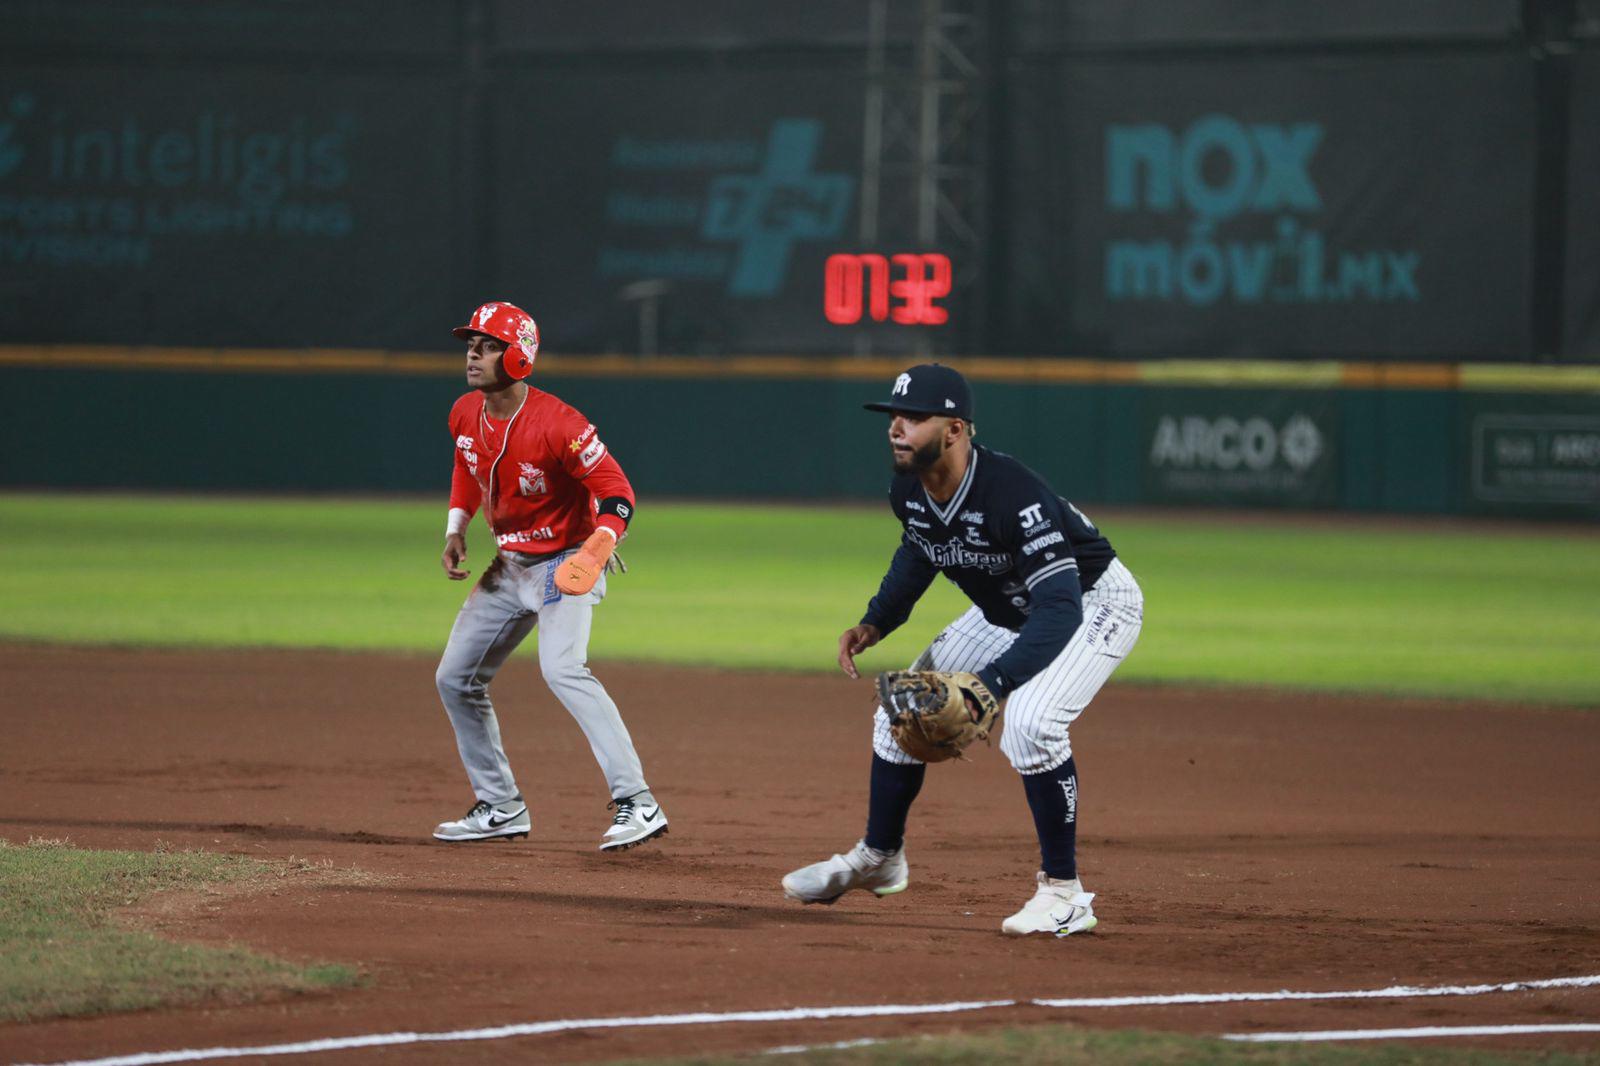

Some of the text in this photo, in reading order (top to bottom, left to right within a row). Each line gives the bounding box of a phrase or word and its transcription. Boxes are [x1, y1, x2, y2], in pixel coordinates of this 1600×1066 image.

[1106, 114, 1325, 216] nox
[1151, 415, 1277, 470] ARCO
[1018, 502, 1043, 528] JT
